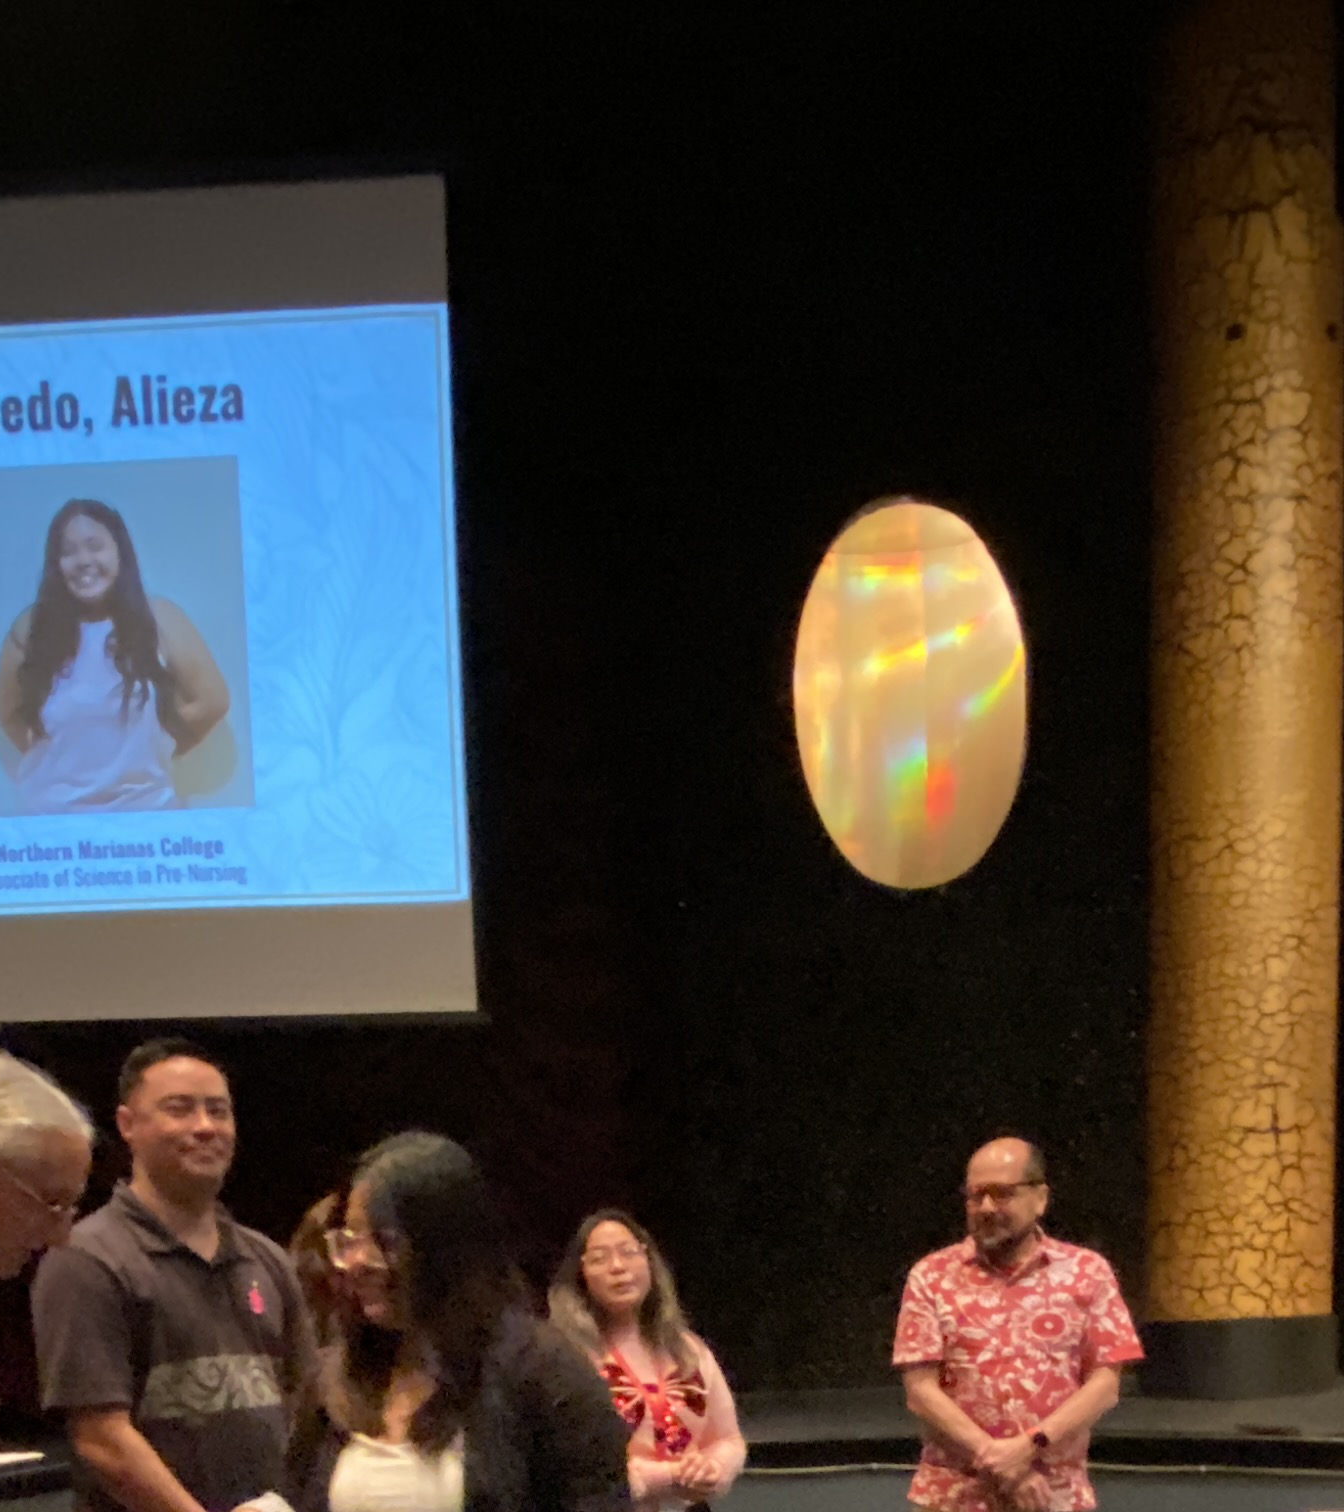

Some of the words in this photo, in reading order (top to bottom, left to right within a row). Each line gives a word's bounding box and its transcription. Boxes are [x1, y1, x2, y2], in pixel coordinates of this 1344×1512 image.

[111, 374, 245, 429] Alieza
[78, 839, 156, 860] Marianas
[160, 836, 225, 859] College
[54, 868, 69, 888] of
[73, 866, 134, 888] Science
[137, 866, 152, 884] in
